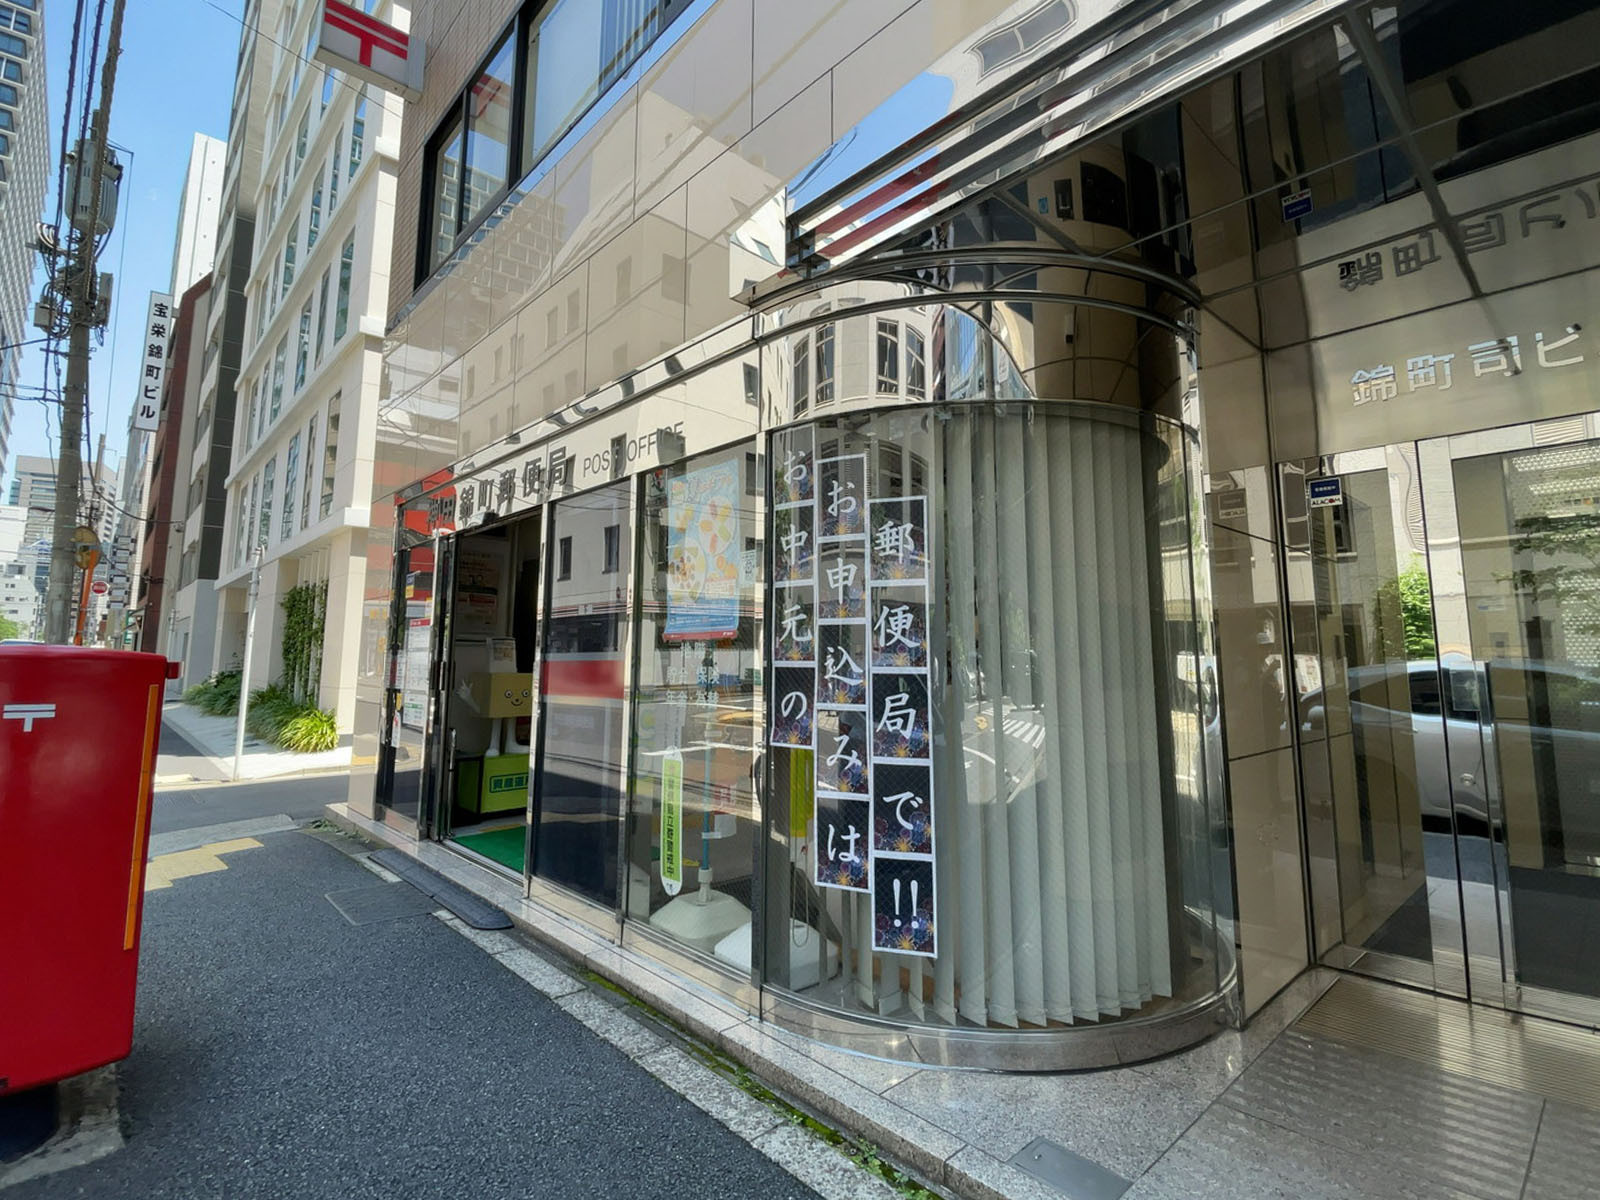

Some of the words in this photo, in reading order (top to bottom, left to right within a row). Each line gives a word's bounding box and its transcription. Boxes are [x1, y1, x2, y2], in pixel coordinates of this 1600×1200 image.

[140, 302, 169, 420] 宝栄錦町ビル
[780, 450, 811, 721] お中元の
[825, 480, 863, 862] お申込みは
